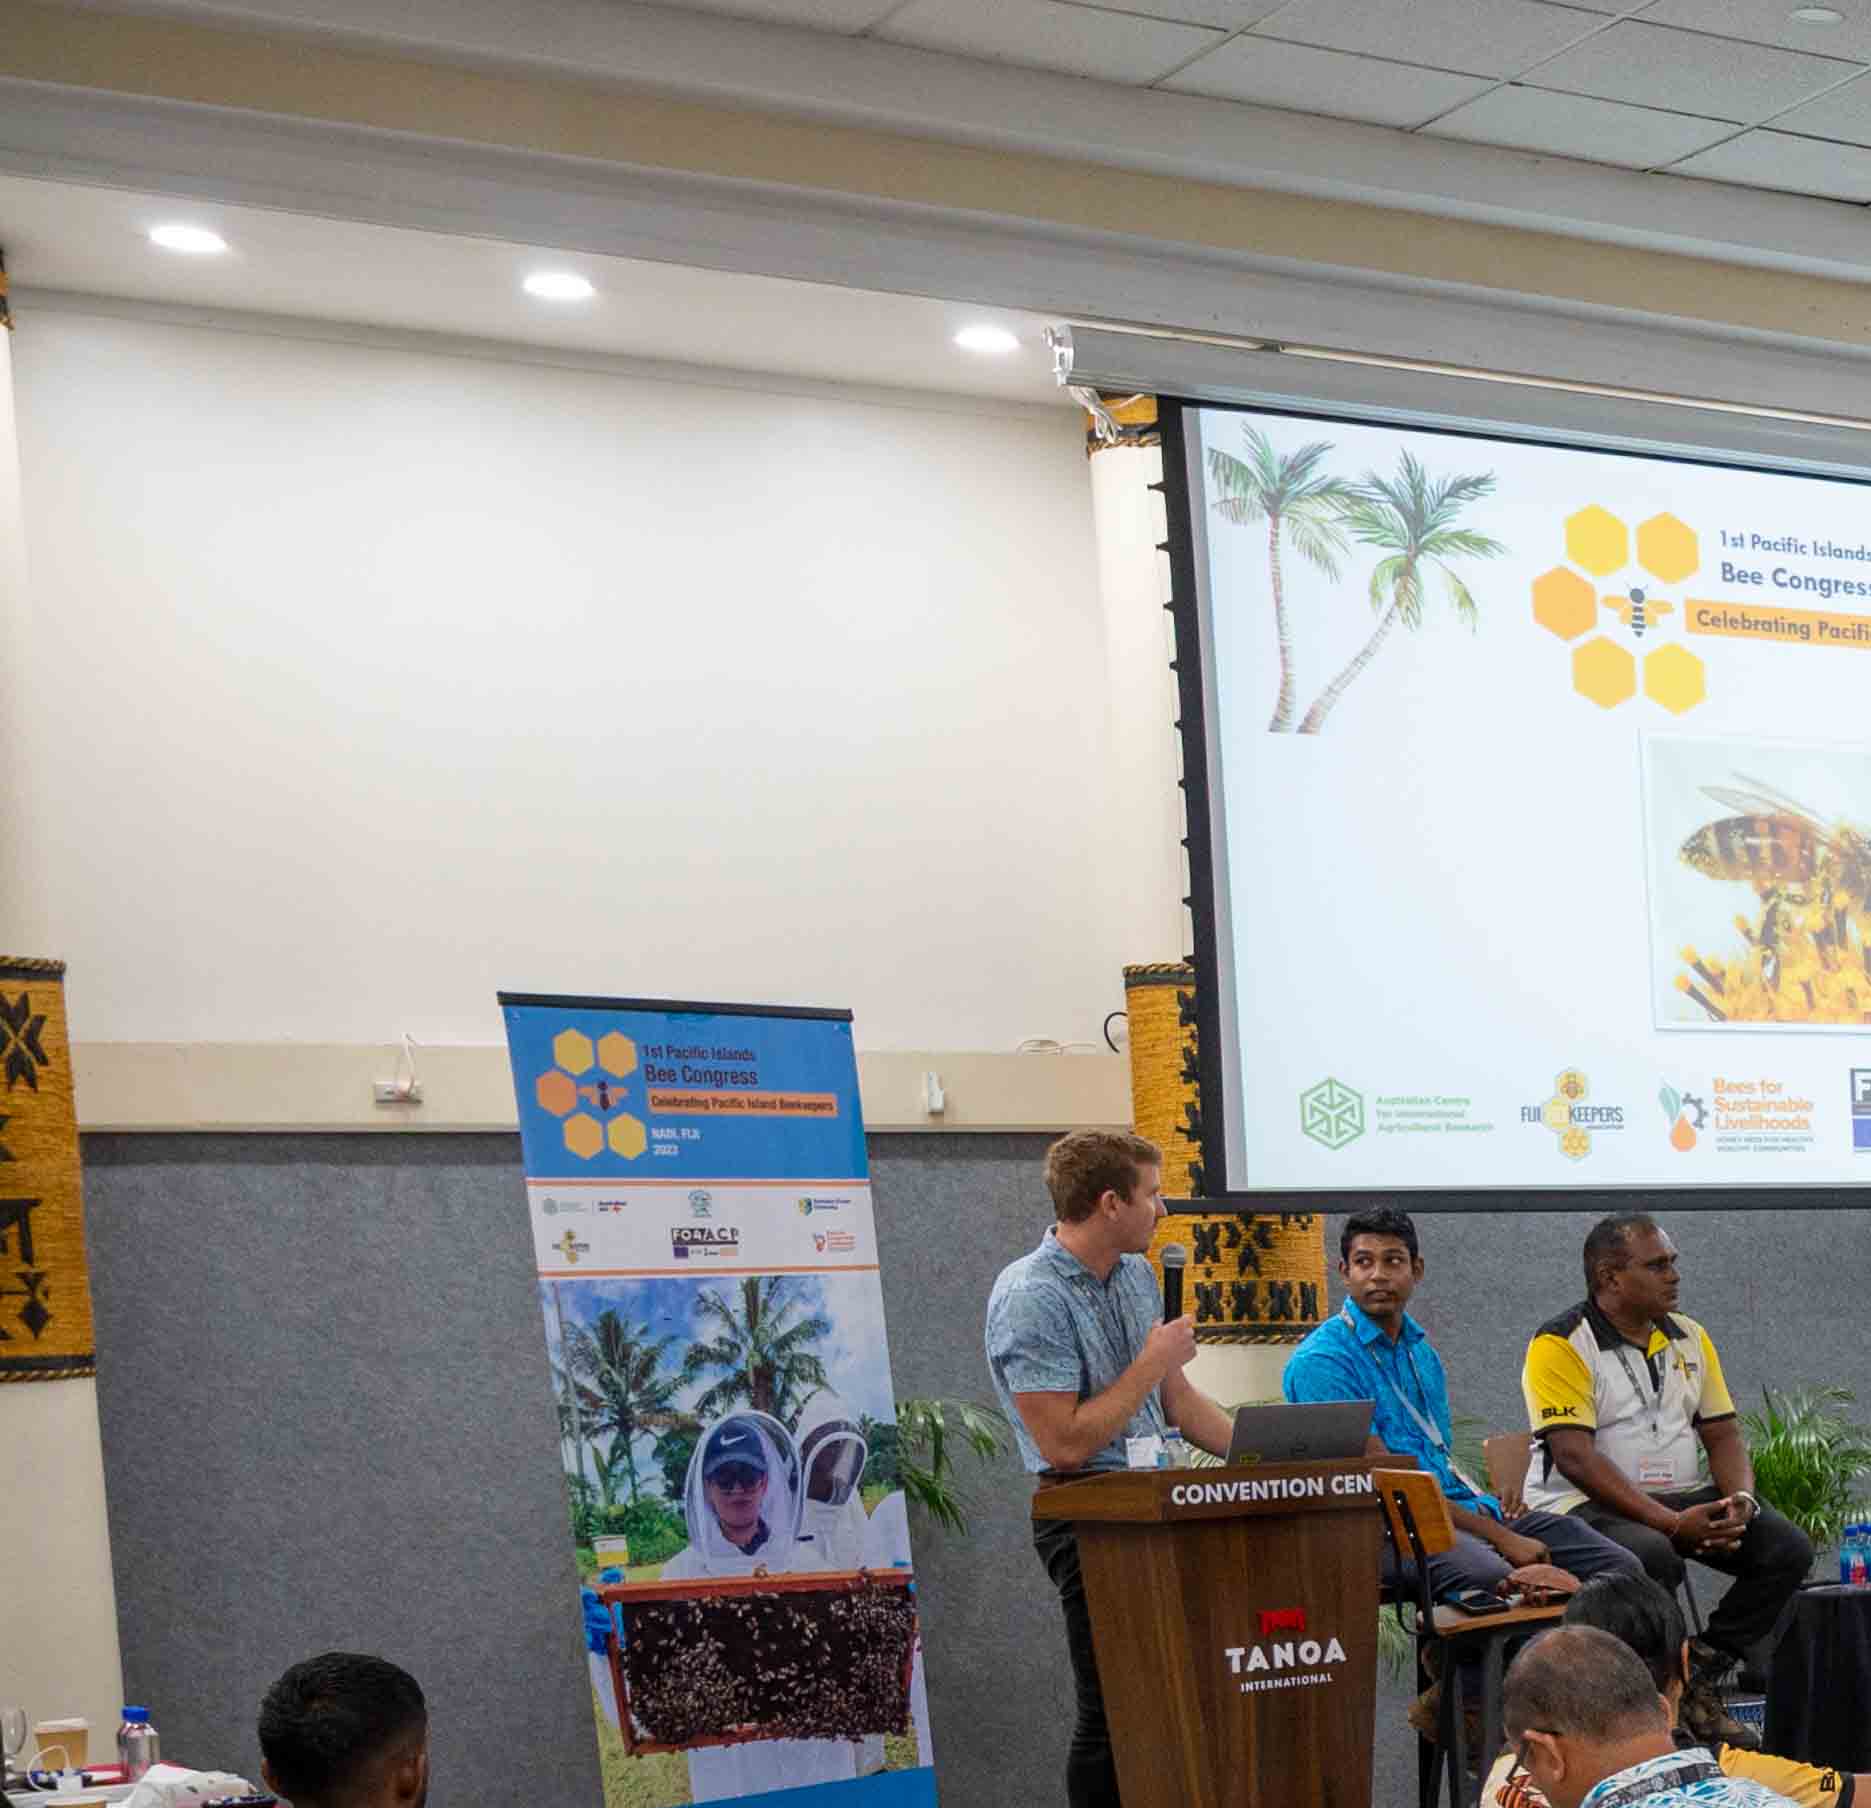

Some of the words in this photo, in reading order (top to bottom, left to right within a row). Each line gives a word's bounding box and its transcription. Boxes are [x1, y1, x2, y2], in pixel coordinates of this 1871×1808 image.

[1719, 529, 1746, 549] 1st
[1751, 532, 1808, 557] Pacific
[1719, 561, 1764, 587] Bee
[1695, 607, 1811, 641] Celebrating
[666, 1045, 709, 1061] Pacific
[711, 1047, 755, 1062] Islands
[644, 1064, 677, 1083] Bee
[681, 1065, 759, 1088] Congress
[1712, 1077, 1757, 1096] Bees
[1760, 1078, 1783, 1097] for
[650, 1095, 710, 1110] Celebrating
[711, 1096, 745, 1109] Pacific
[747, 1098, 777, 1110] Island
[779, 1098, 834, 1112] Beekeepers
[1712, 1095, 1815, 1114] Sustainable
[1713, 1113, 1810, 1132] Livelihoods
[1170, 1477, 1326, 1507] CONVENTION
[1330, 1473, 1375, 1496] CEN
[1224, 1637, 1347, 1674] TANOA
[1240, 1672, 1334, 1694] INTERNATIONAL
